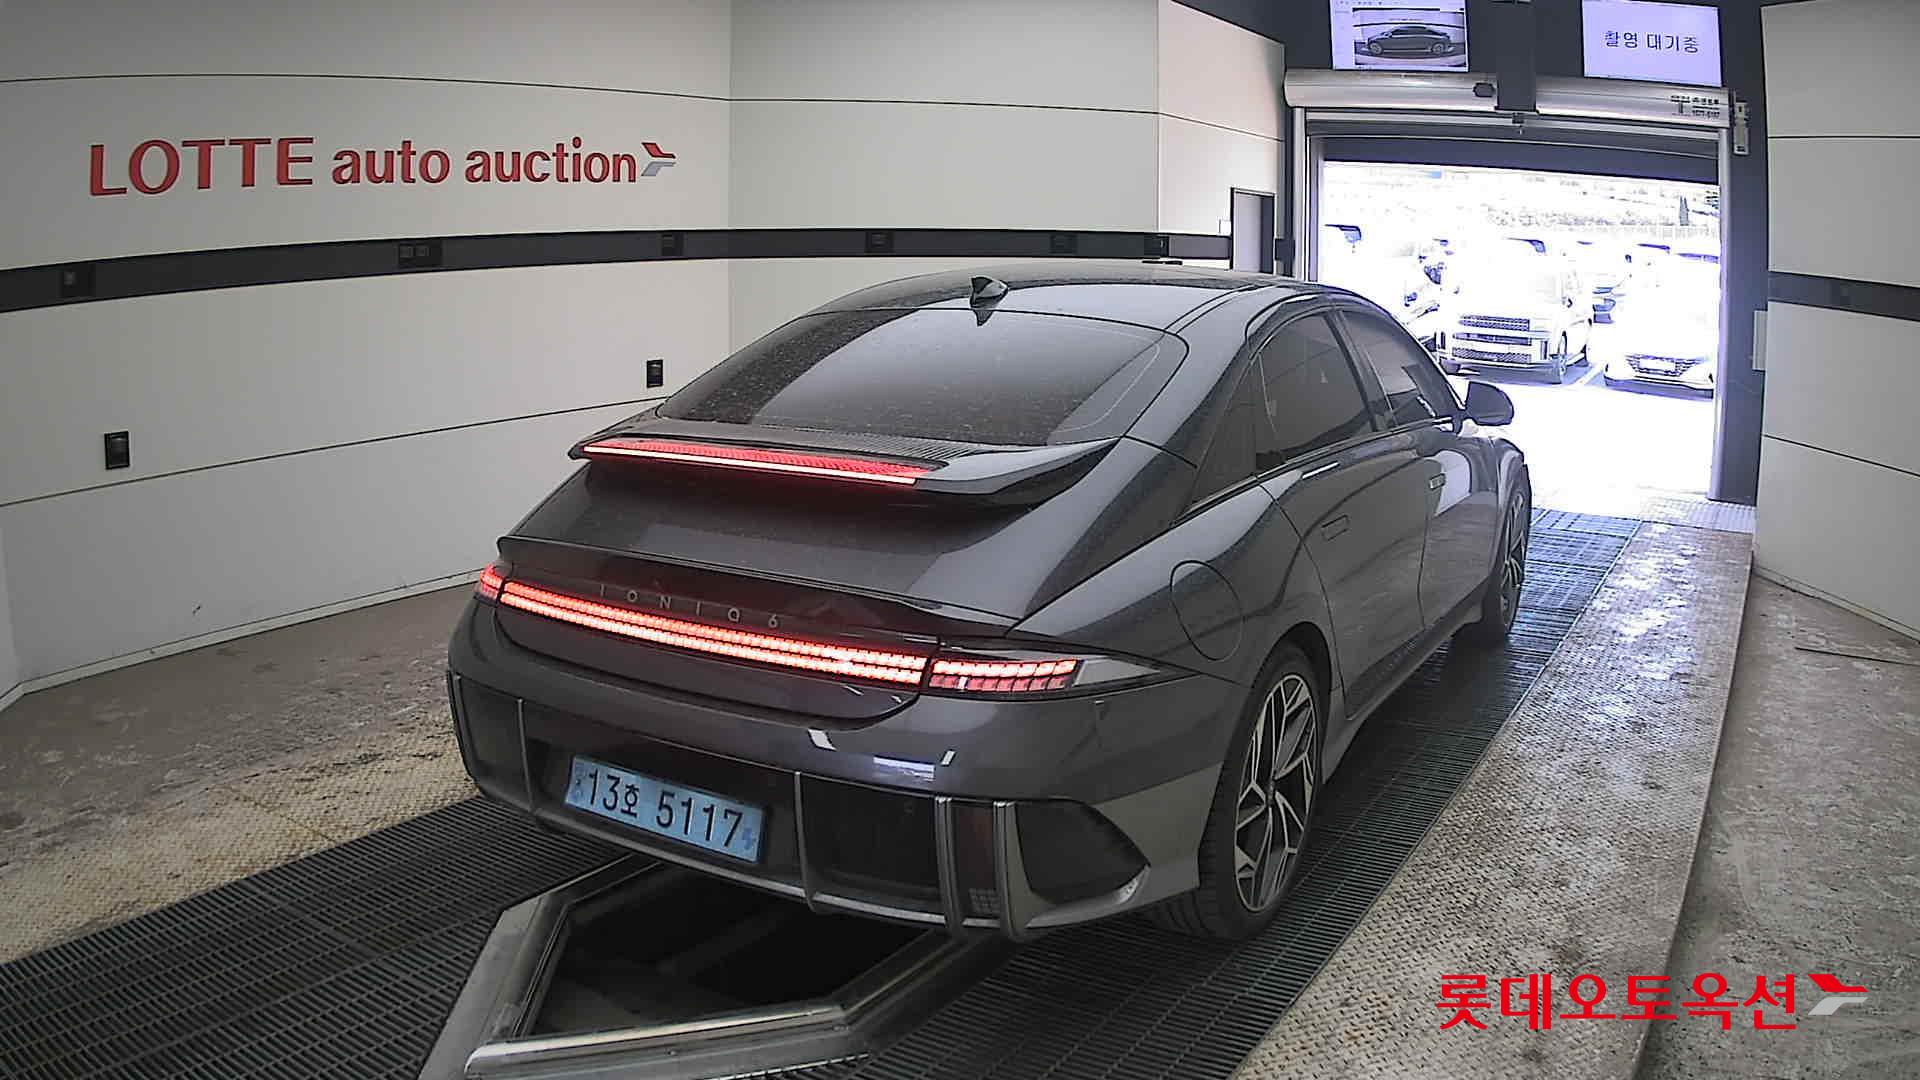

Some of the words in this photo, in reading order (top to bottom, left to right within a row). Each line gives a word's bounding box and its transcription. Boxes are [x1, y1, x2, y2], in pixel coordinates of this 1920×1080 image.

[1604, 30, 1638, 49] 촬영
[1646, 33, 1699, 53] 대기중
[90, 137, 314, 196] LOTTE
[331, 141, 450, 185] auto
[464, 137, 638, 184] auction
[600, 584, 740, 622] IONIQ
[768, 613, 778, 628] 6
[589, 768, 640, 818] 13호
[655, 792, 743, 847] 5117
